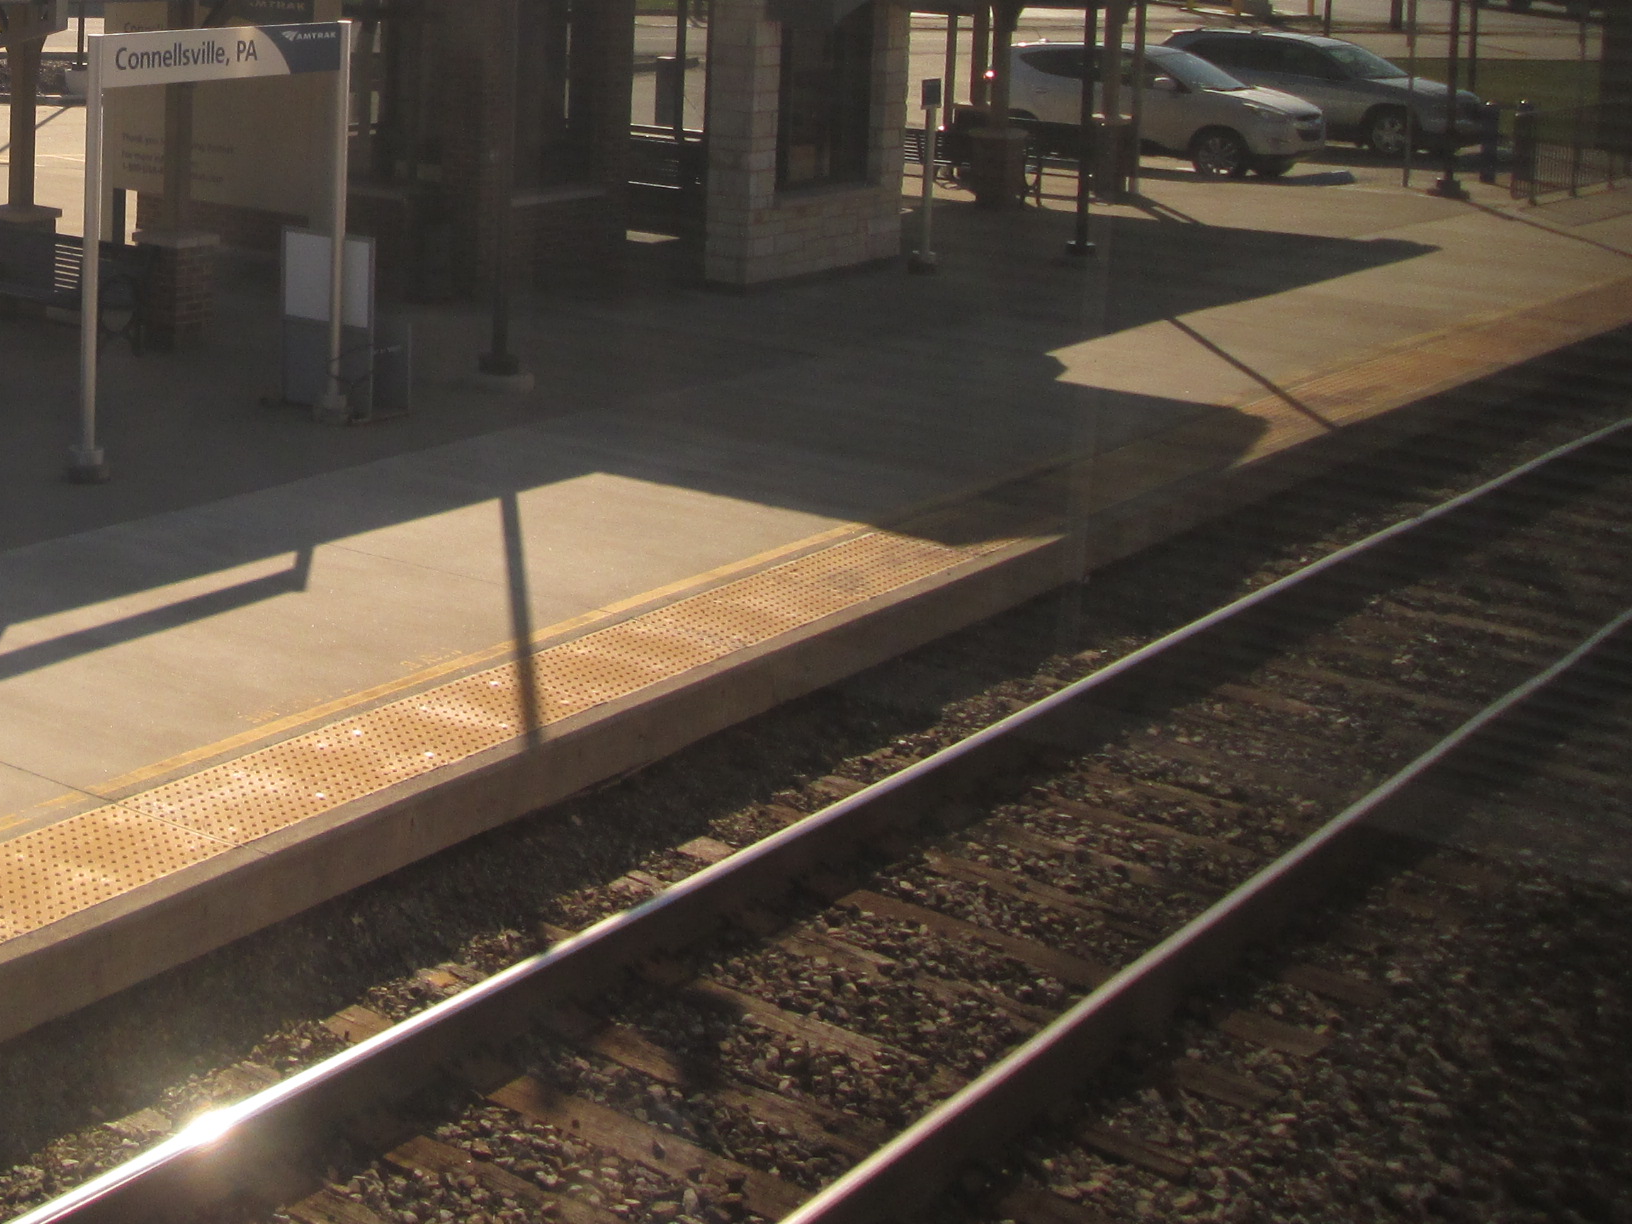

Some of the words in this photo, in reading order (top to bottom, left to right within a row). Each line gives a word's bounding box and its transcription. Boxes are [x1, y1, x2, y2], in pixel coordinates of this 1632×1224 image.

[295, 31, 336, 40] AMTRAK
[115, 40, 230, 71] Connellsville,
[236, 39, 258, 63] PA
